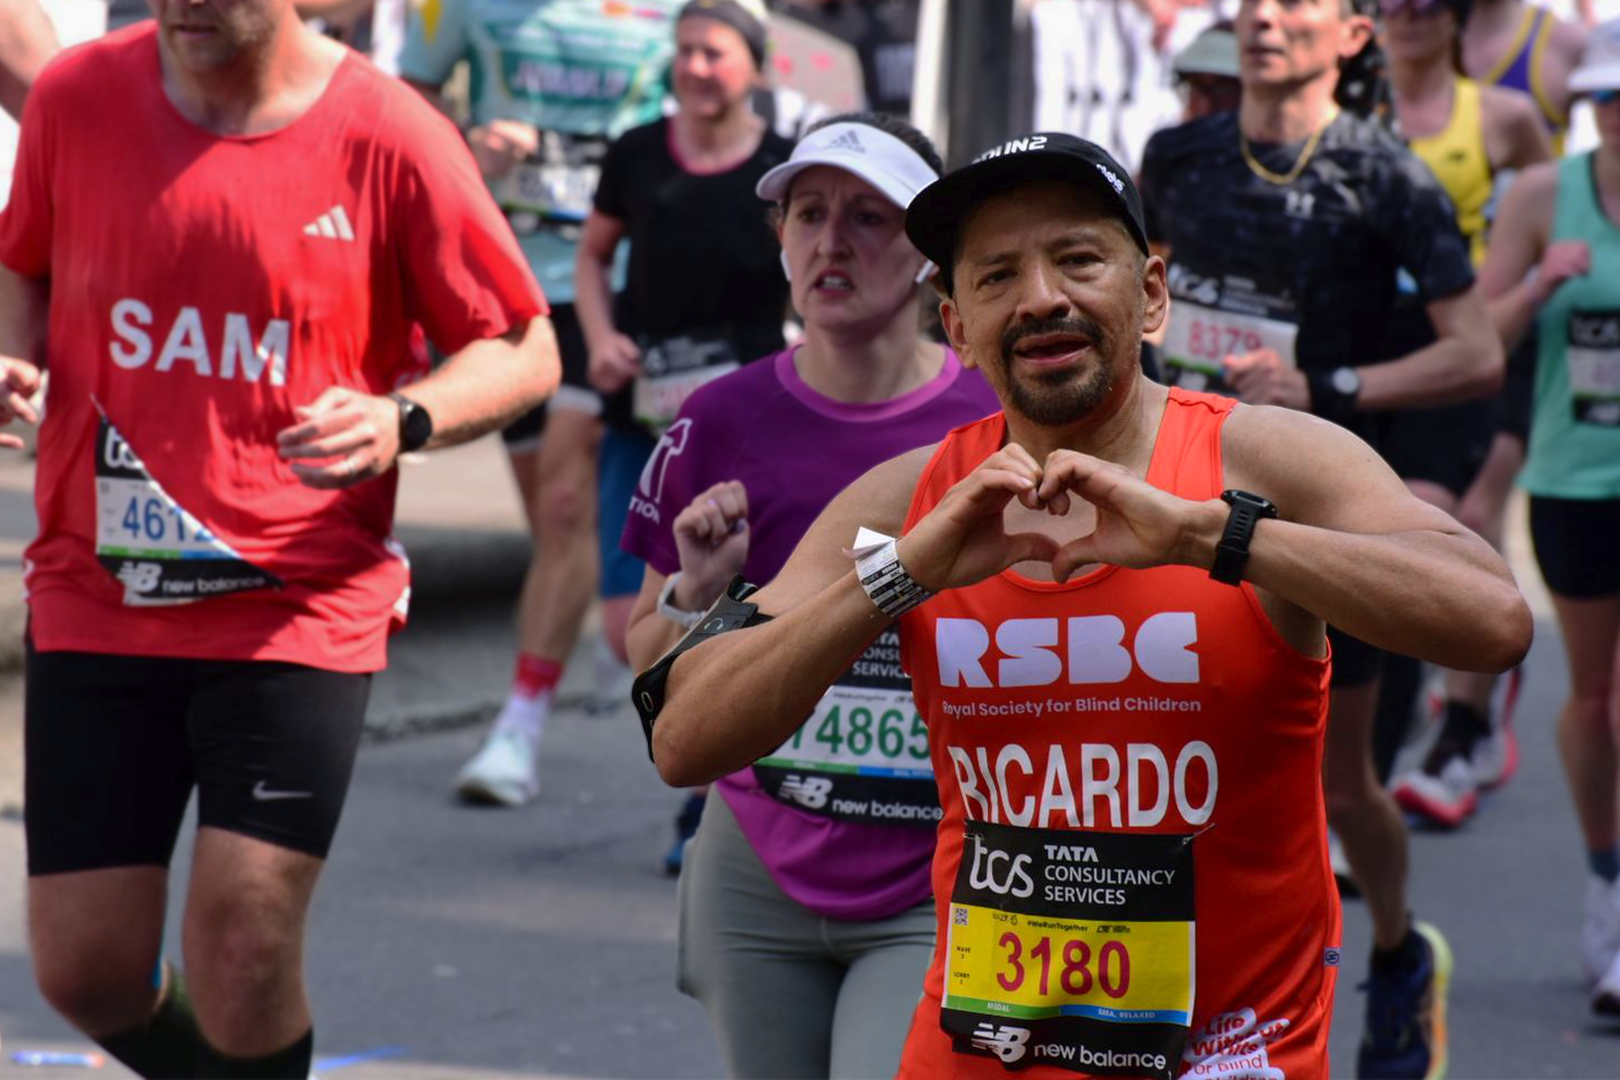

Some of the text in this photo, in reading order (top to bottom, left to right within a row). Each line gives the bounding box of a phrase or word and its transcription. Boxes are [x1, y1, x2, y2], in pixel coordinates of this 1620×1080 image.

[109, 298, 290, 387] SAM
[162, 579, 196, 592] new
[198, 577, 265, 592] balance
[935, 611, 1200, 688] RSBC
[943, 697, 1201, 718] Royal Society for Blind Children
[947, 740, 1219, 828] RICARDO
[832, 799, 868, 814] new
[871, 800, 944, 820] balance
[1044, 844, 1099, 863] TATA
[969, 834, 1035, 898] tcs
[1044, 865, 1176, 886] CONSULTANCY
[1044, 885, 1127, 905] SERVICES
[996, 931, 1131, 999] 3180
[1034, 1042, 1076, 1060] new
[1079, 1044, 1167, 1070] balance
